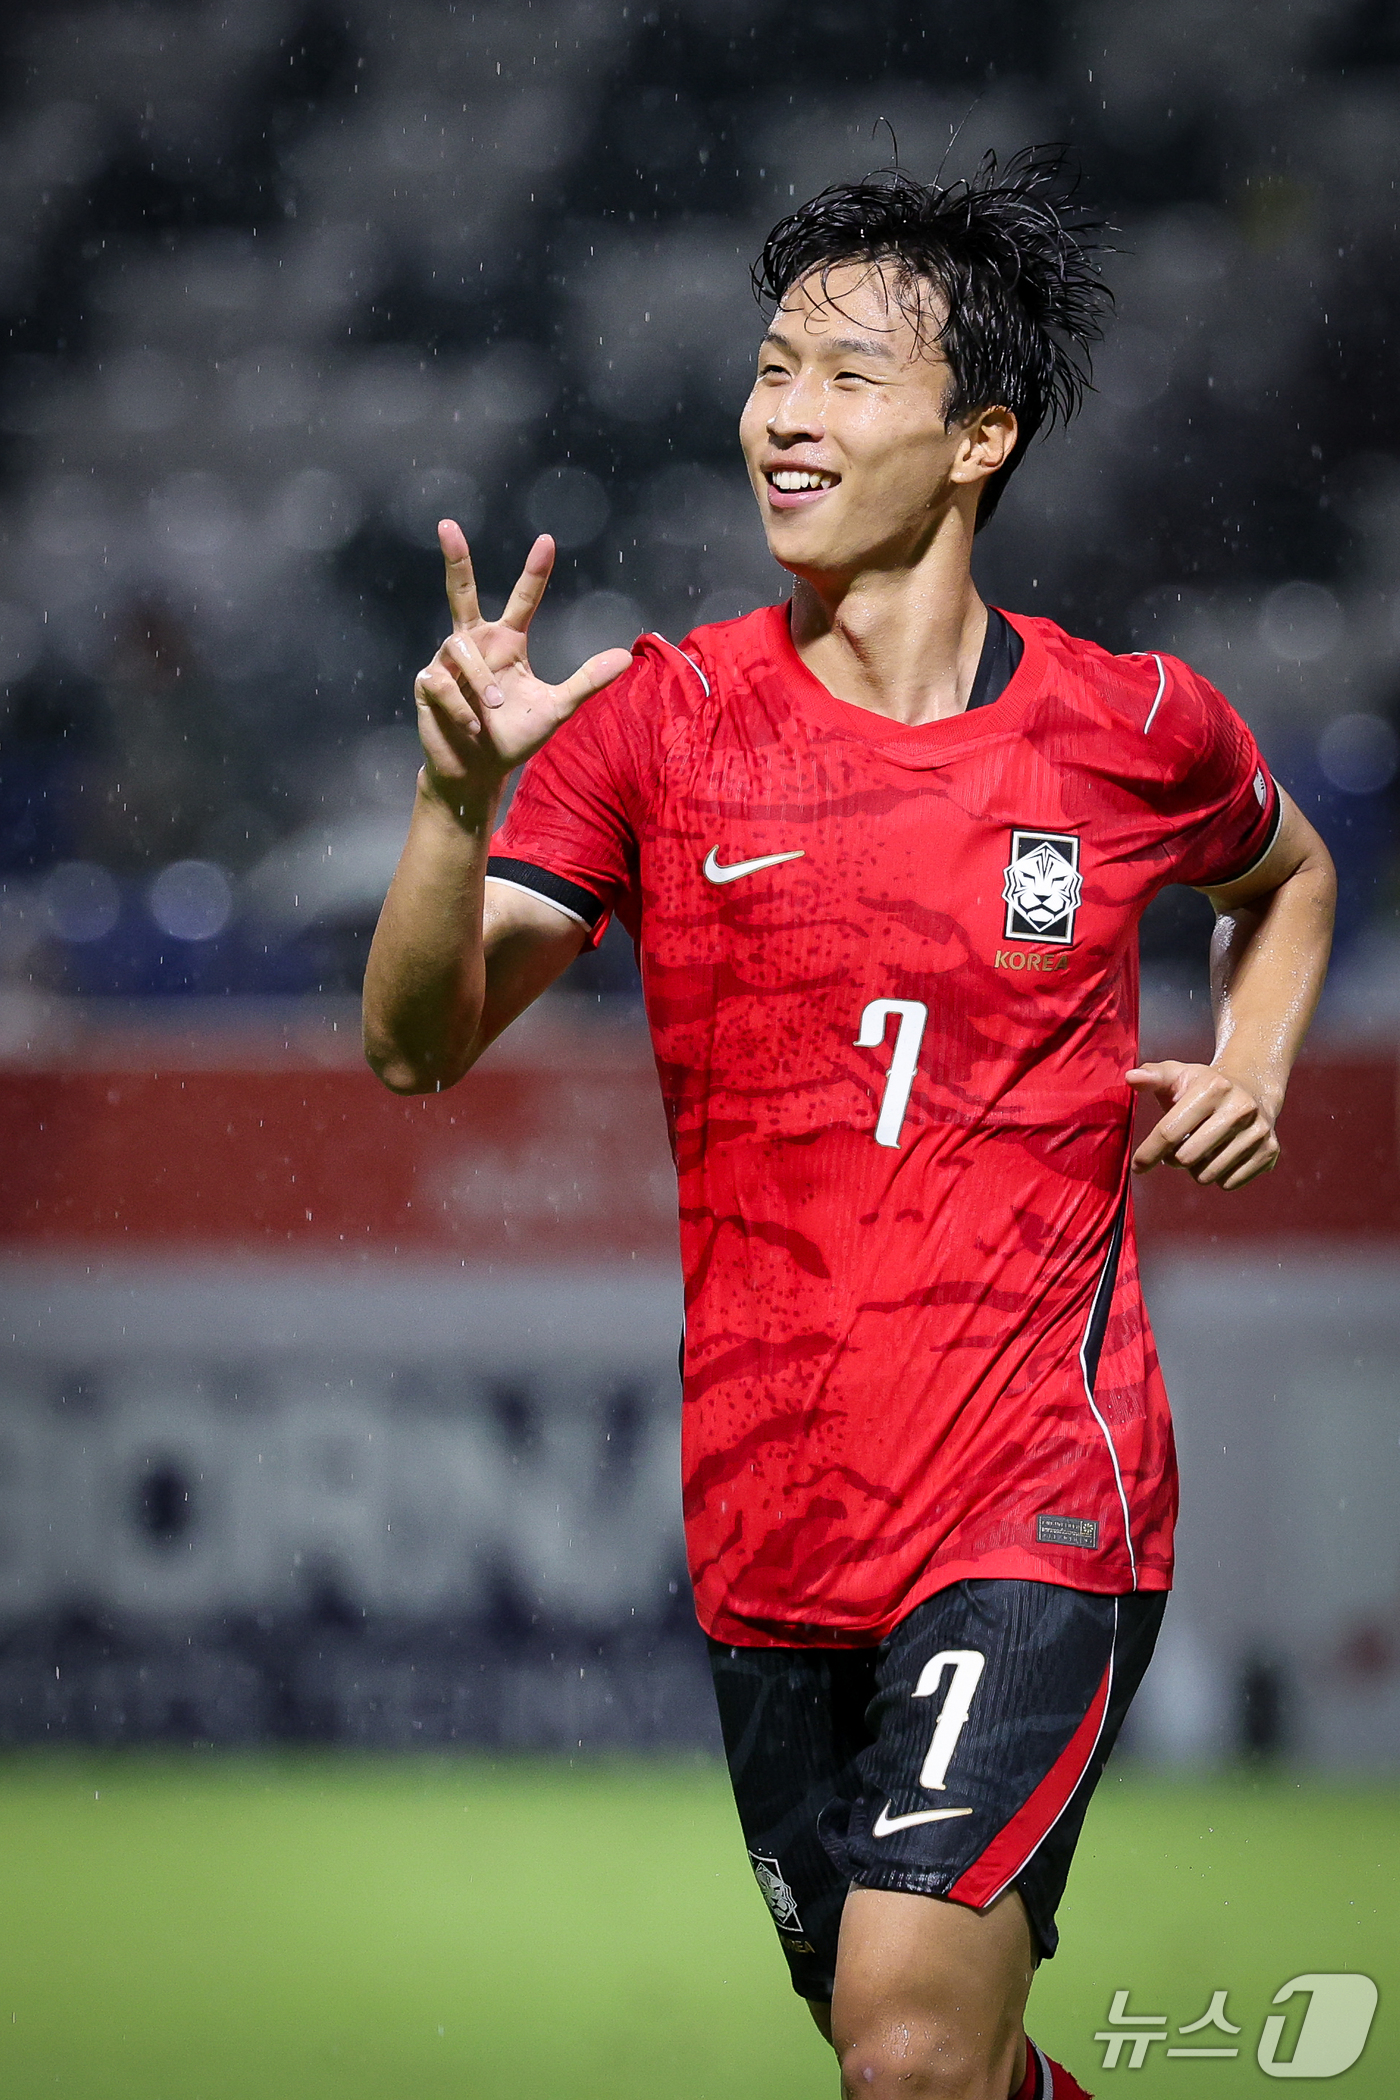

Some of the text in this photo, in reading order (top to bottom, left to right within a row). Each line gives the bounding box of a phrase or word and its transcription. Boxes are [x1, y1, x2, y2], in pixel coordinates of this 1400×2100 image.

[994, 950, 1069, 972] KOREA
[853, 998, 928, 1149] 7
[911, 1649, 986, 1791] 7
